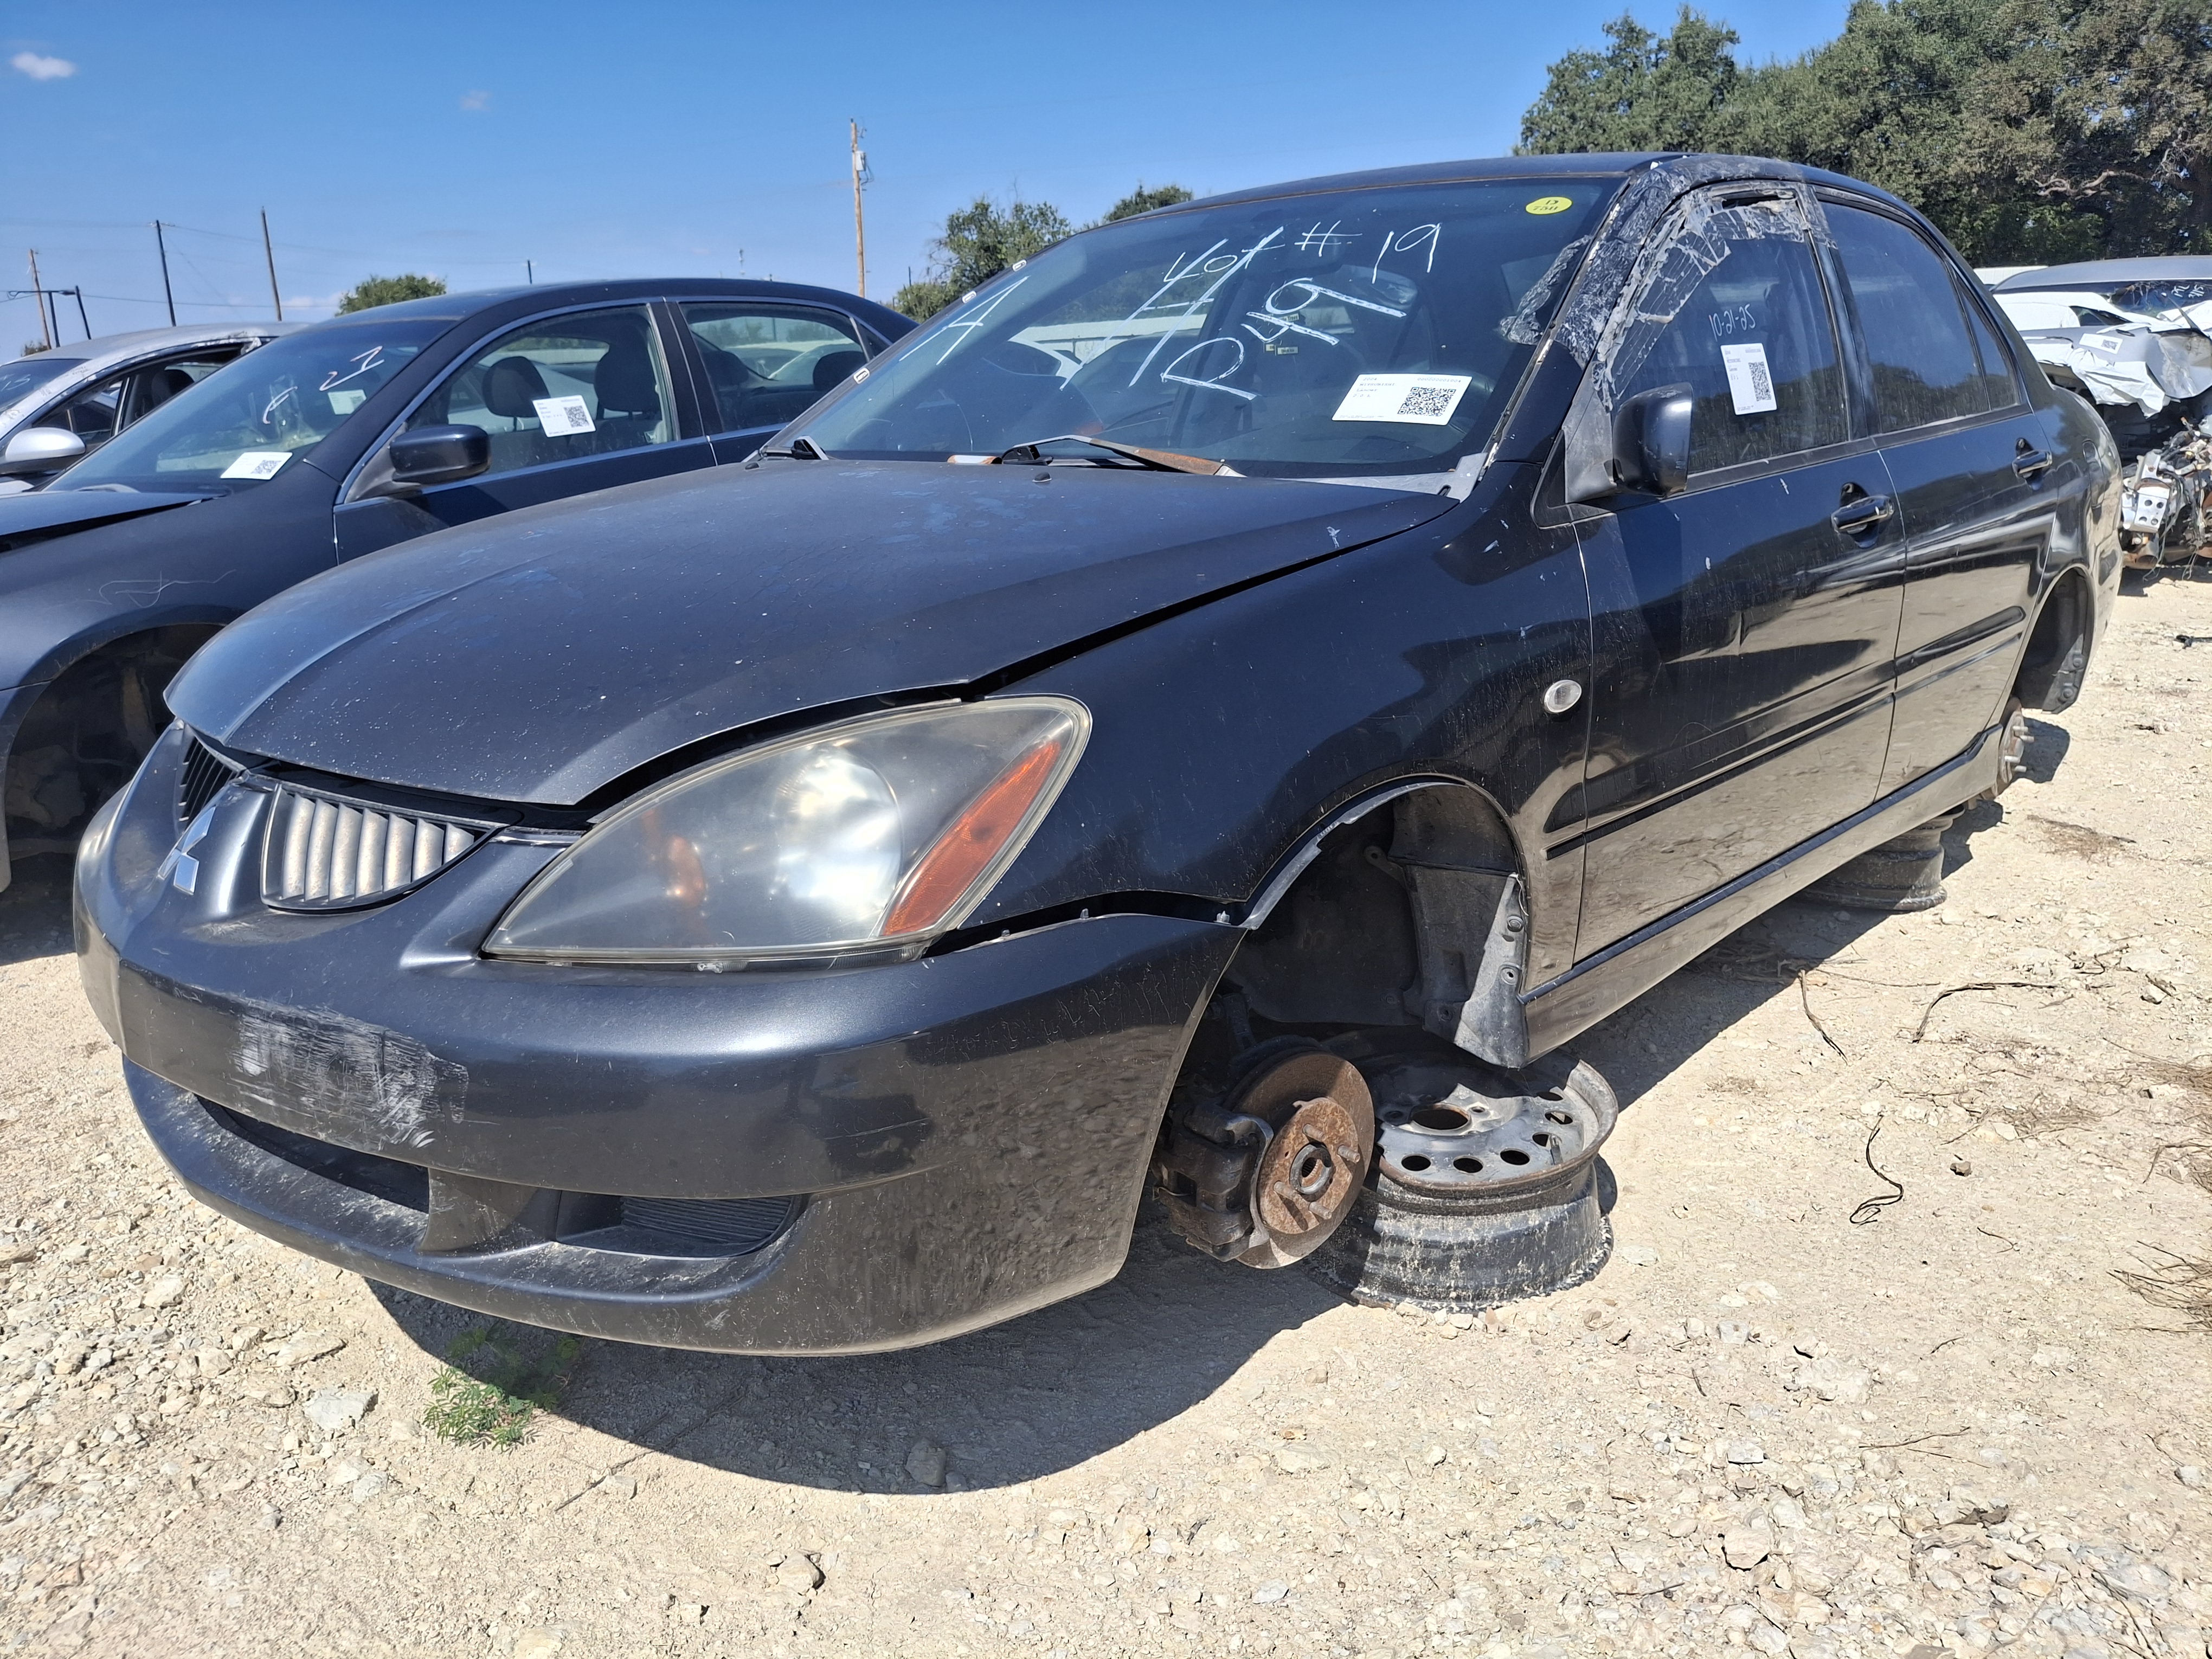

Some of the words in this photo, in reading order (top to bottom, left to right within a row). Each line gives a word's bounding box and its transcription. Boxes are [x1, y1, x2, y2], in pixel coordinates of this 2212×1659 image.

[1163, 237, 1285, 282] Lot
[1294, 220, 1363, 258] #
[1371, 222, 1442, 284] 19
[1709, 303, 1756, 342] 10-21-25
